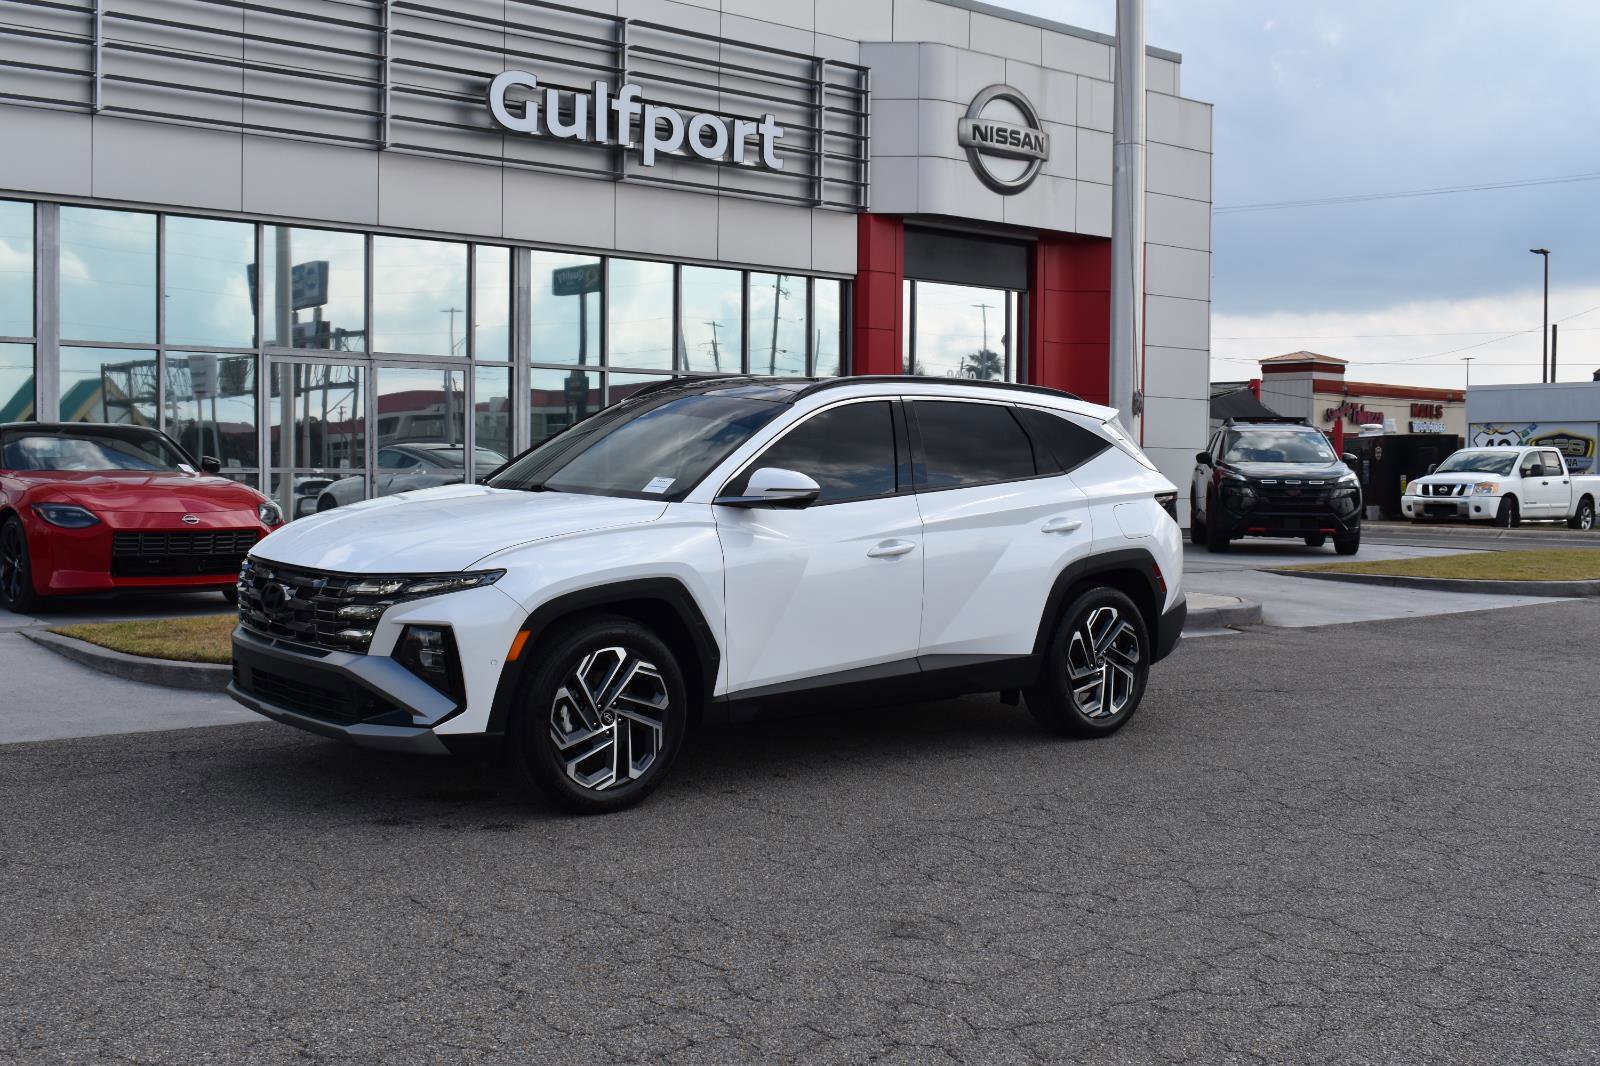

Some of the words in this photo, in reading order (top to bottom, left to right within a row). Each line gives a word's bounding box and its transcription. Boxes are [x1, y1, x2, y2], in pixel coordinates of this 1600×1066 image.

[488, 70, 784, 169] Gulfport
[972, 124, 1044, 153] NISSAN
[1410, 403, 1443, 419] NAILS
